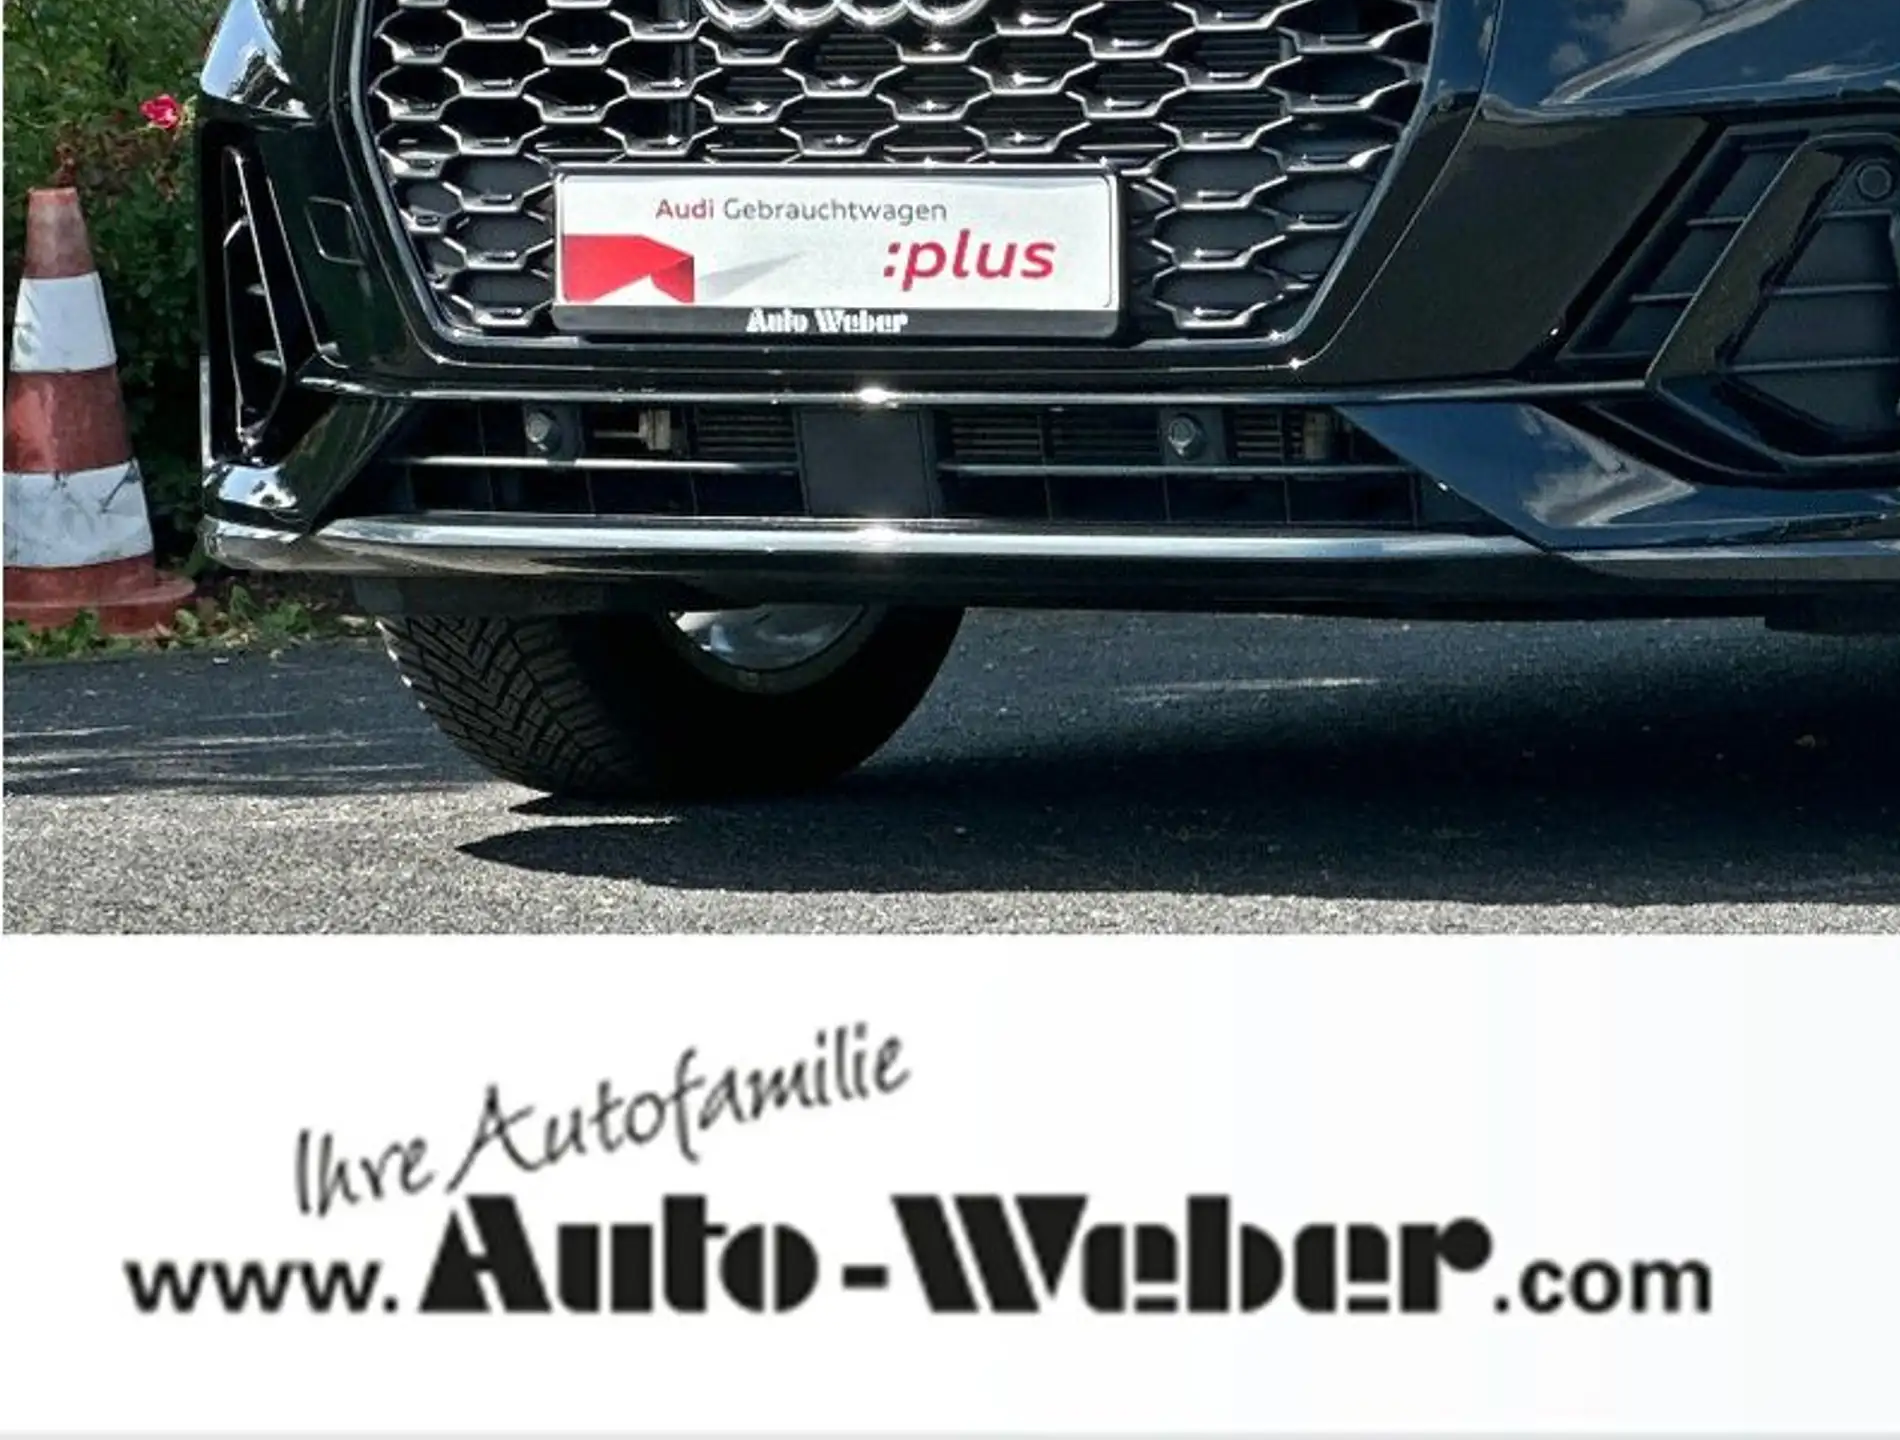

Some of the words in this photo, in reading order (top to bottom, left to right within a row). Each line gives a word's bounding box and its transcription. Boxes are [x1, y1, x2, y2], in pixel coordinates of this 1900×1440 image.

[655, 198, 715, 220] Audi
[723, 198, 948, 226] Gebrauchtwagen
[882, 229, 1057, 292] :plus
[746, 308, 810, 334] Auto
[814, 308, 909, 334] Weber
